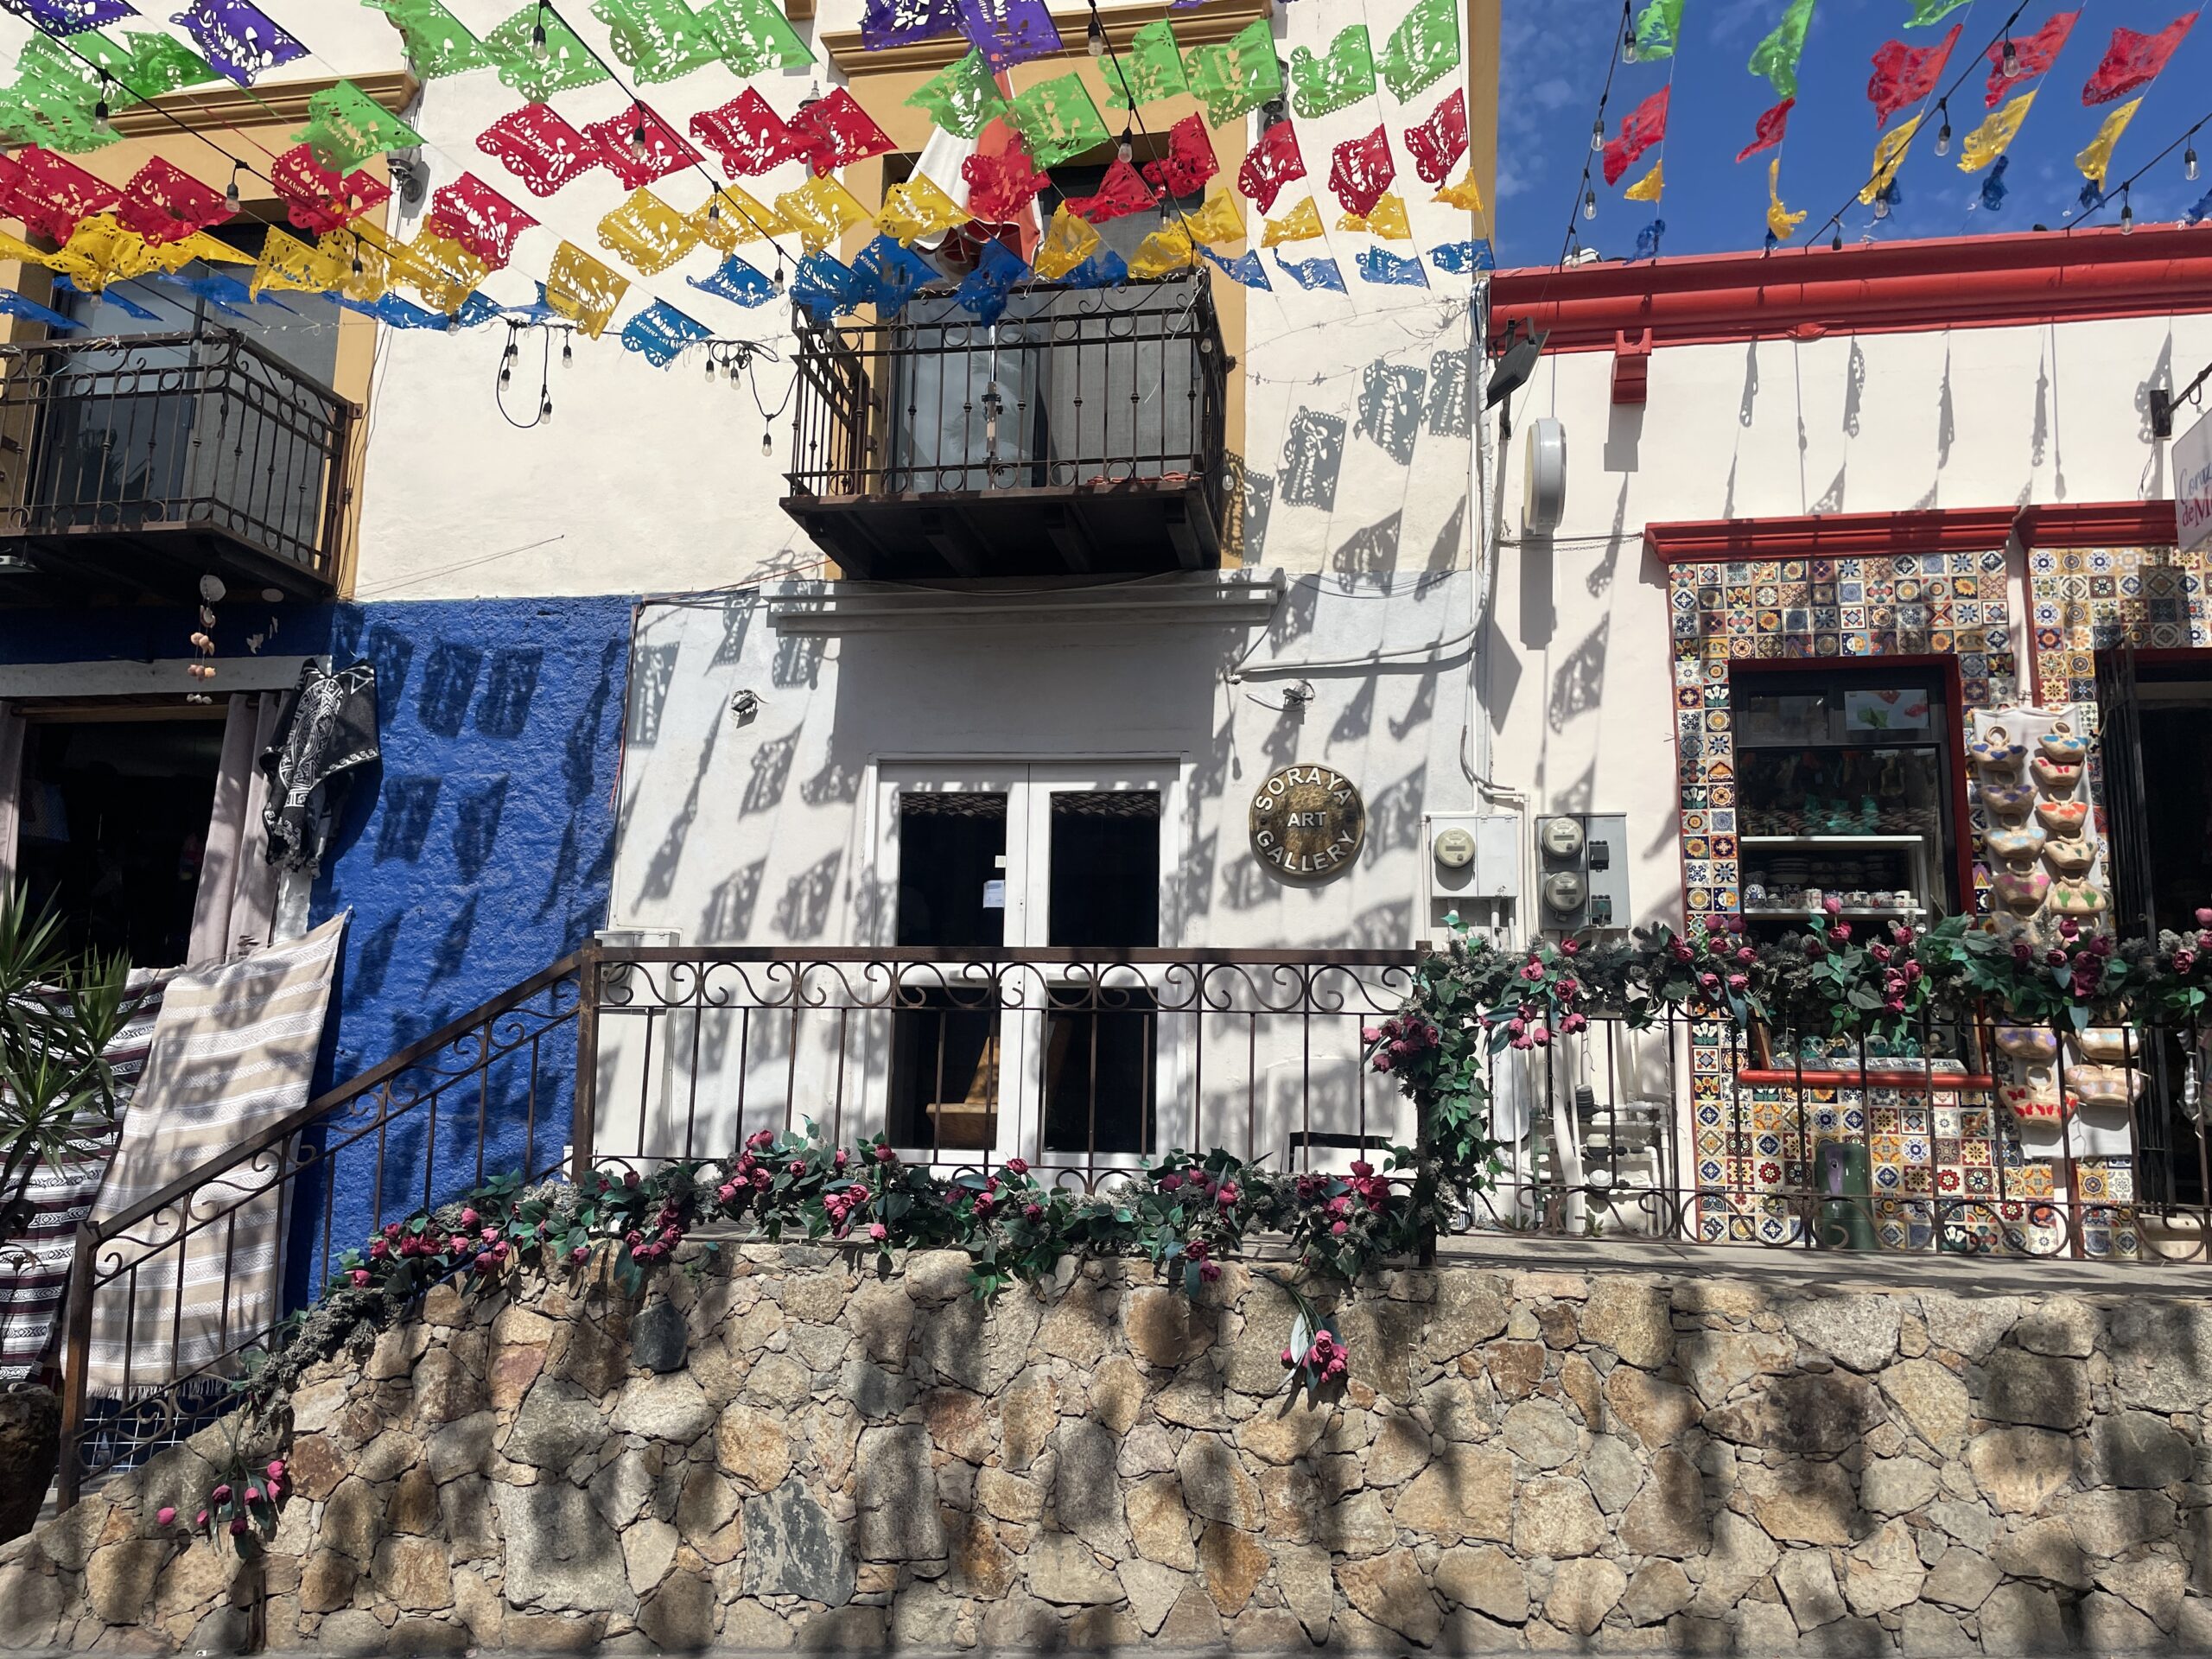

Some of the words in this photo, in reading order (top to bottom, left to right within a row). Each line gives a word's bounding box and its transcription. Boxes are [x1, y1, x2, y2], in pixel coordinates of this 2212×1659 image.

[2182, 505, 2194, 527] de
[2194, 485, 2212, 527] M
[1255, 767, 1352, 811] SORAYA
[1287, 811, 1326, 827] ART
[1256, 830, 1356, 872] GALLERY
